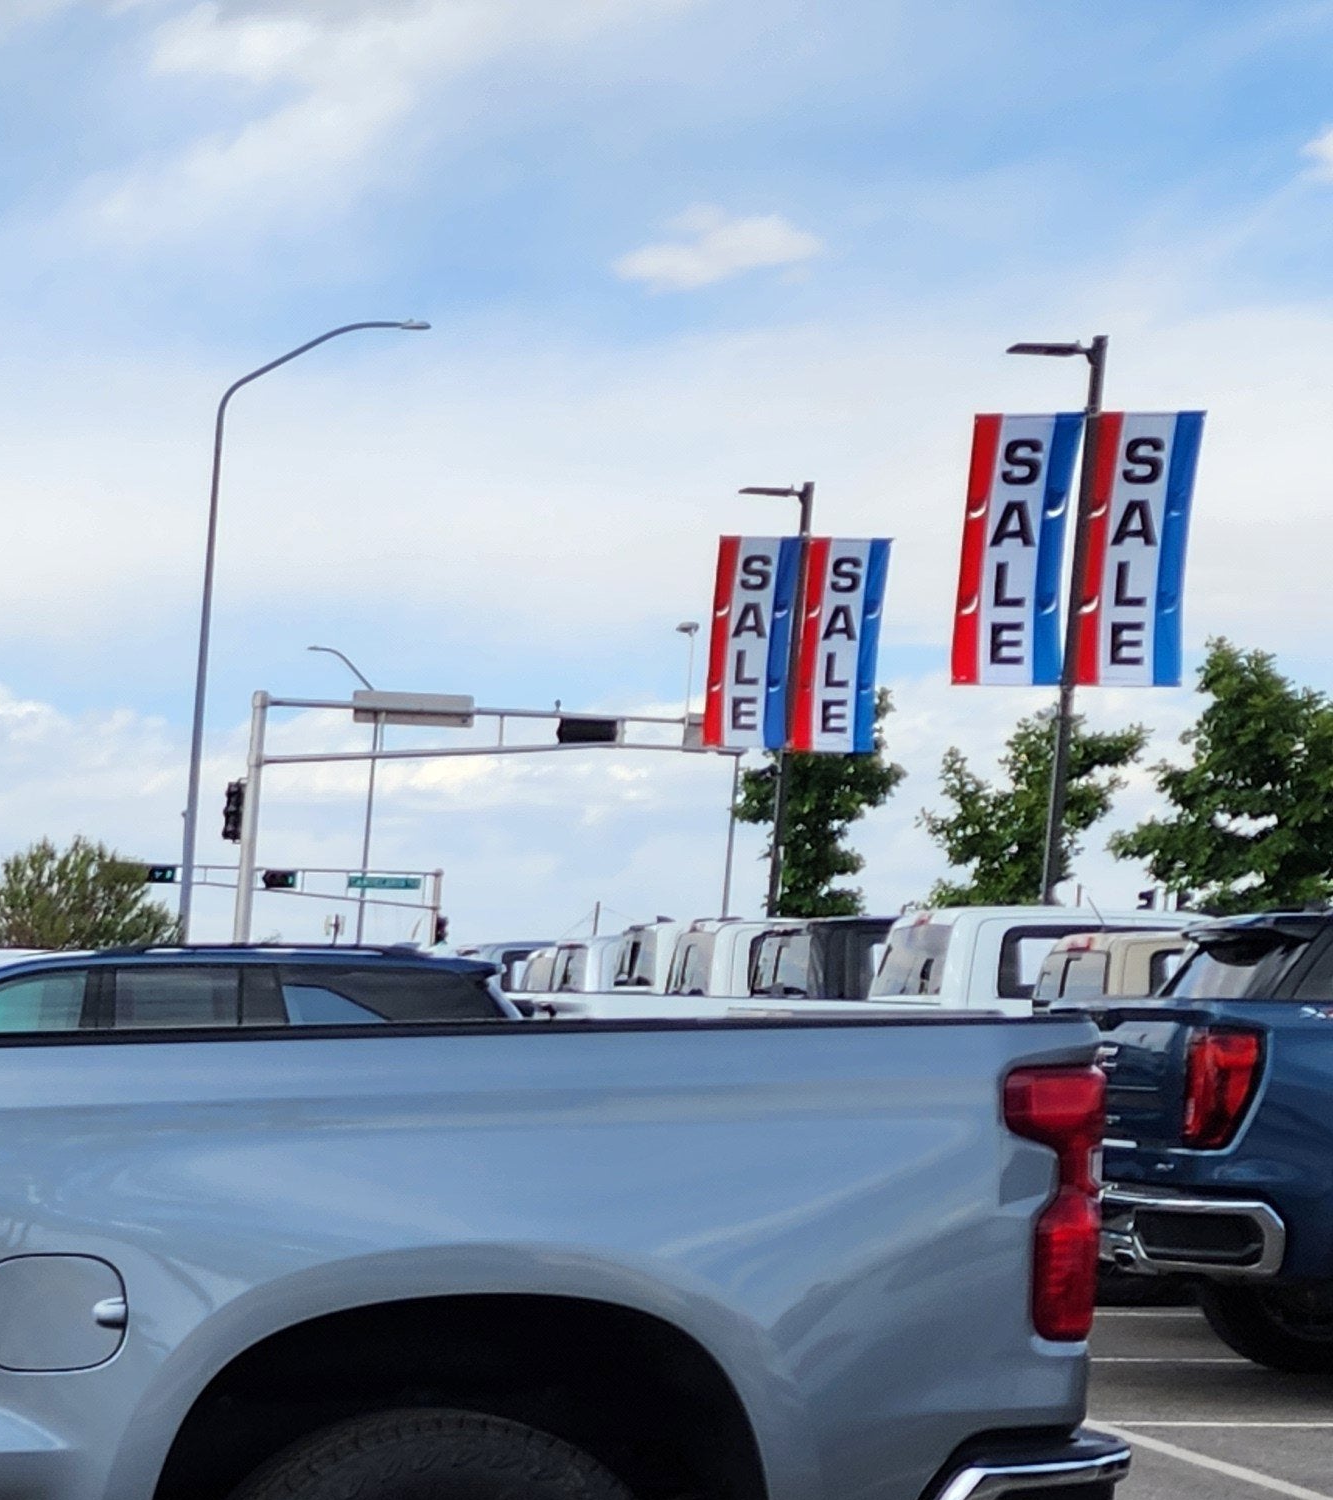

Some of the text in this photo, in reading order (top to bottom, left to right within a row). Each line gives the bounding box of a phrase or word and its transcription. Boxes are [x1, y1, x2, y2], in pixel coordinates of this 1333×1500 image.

[732, 554, 773, 731] SALE
[821, 557, 863, 734] SALE
[989, 438, 1044, 665] SALE
[1110, 437, 1166, 666] SALE
